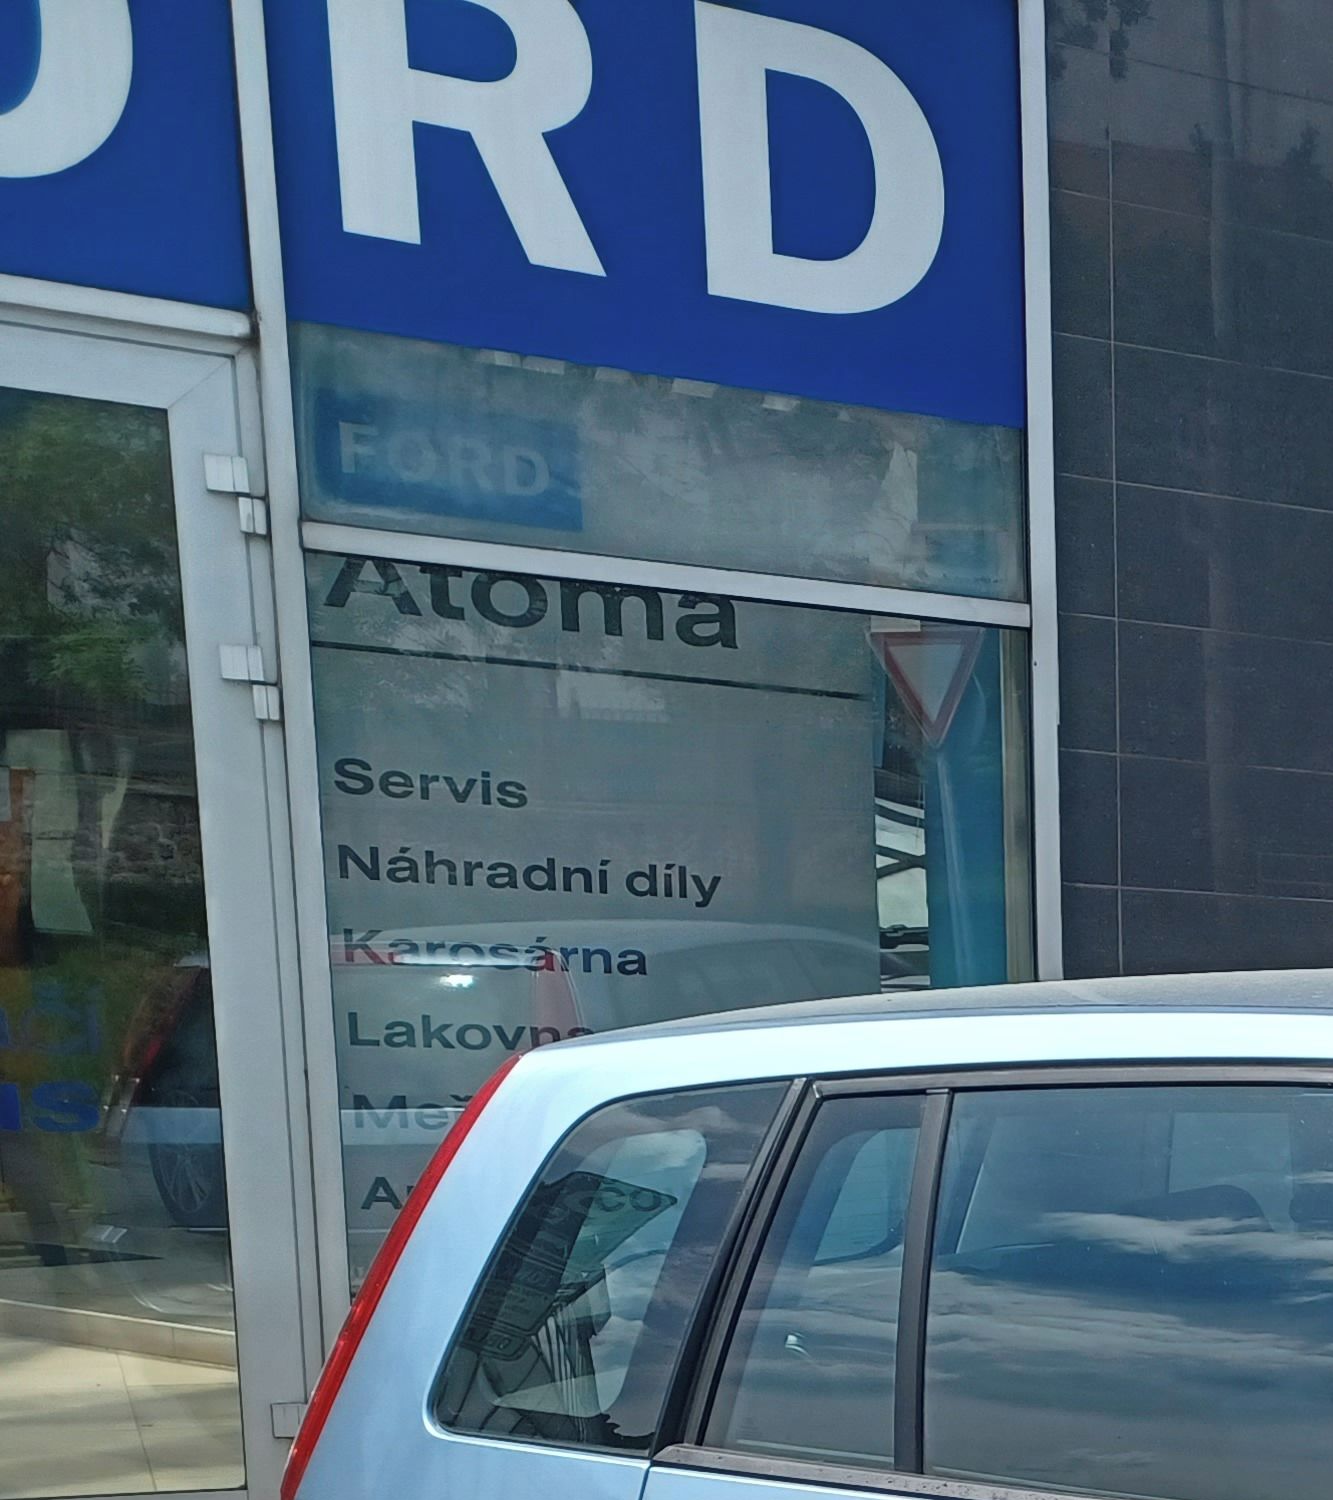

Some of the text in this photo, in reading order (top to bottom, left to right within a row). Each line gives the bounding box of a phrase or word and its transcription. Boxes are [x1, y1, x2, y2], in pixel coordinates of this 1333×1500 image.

[338, 420, 551, 497] FORD
[323, 557, 739, 650] Atoma
[333, 757, 528, 809] Servis
[337, 844, 721, 908] Náhradní díly
[343, 927, 647, 976] Karosárna
